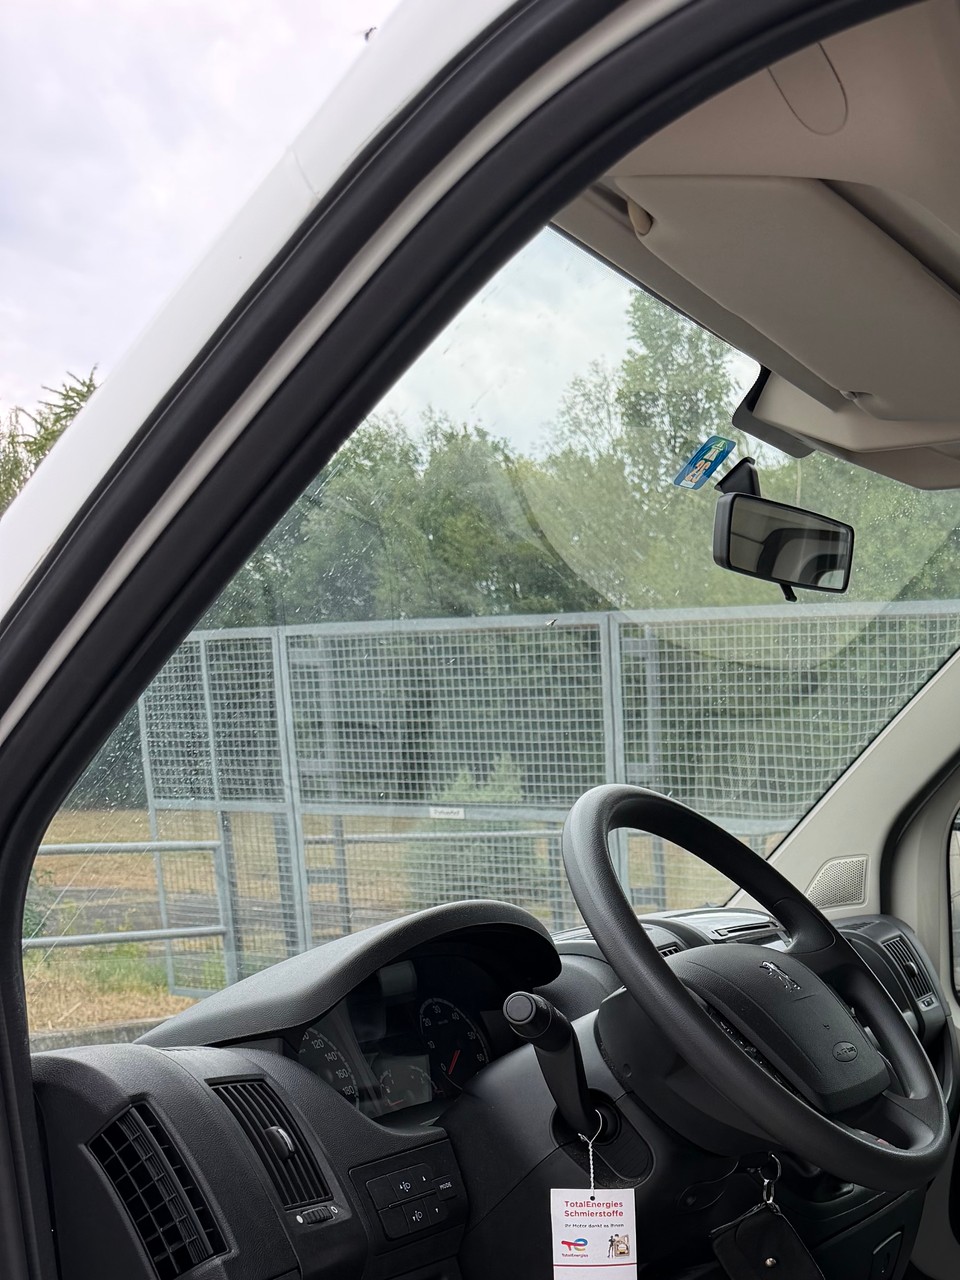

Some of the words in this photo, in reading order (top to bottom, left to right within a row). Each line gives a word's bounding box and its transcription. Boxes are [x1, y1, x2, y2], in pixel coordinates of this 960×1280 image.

[422, 1017, 431, 1027] 20
[311, 1039, 324, 1049] 120
[427, 1040, 435, 1049] 10
[325, 1051, 338, 1062] 140
[335, 1068, 349, 1079] 160
[342, 1086, 355, 1096] 180
[439, 1182, 453, 1190] MODE
[564, 1201, 623, 1209] TotalEnergies
